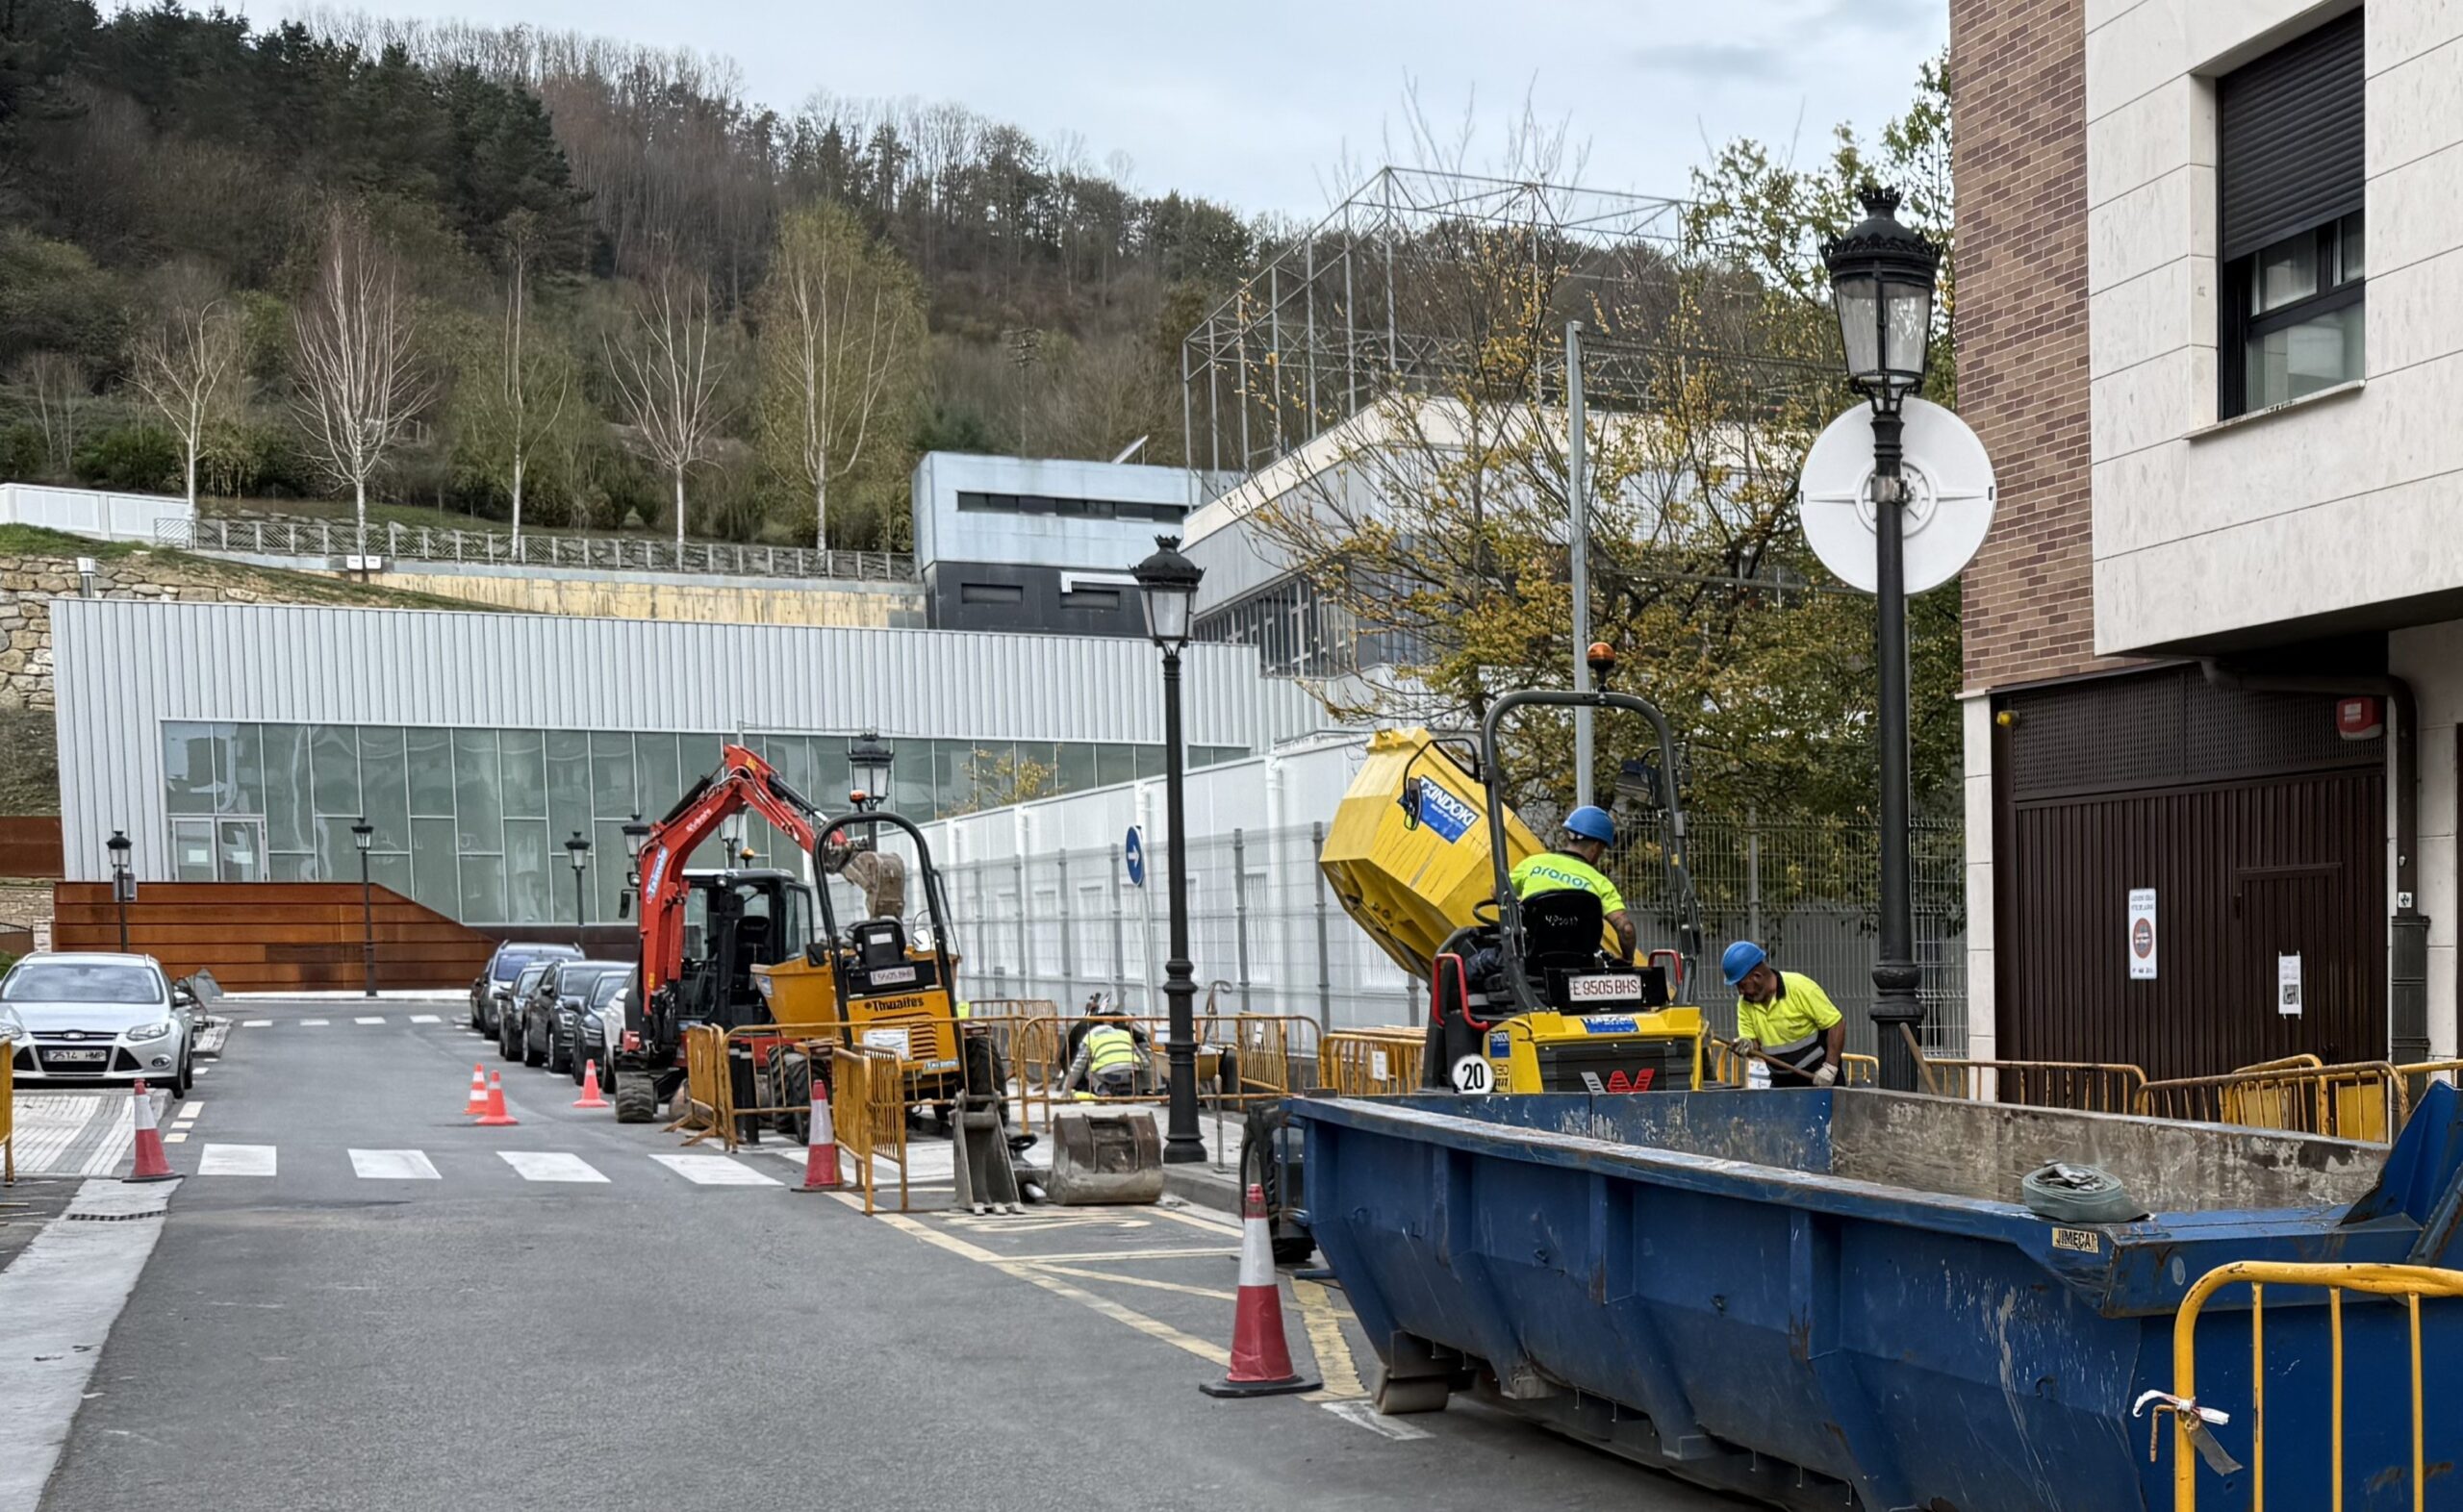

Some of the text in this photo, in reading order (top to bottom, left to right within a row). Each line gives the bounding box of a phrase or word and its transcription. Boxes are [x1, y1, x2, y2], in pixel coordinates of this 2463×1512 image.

[1421, 776, 1479, 826] TXINDOKI
[1583, 980, 1613, 995] 9505
[1615, 979, 1638, 995] BHS
[1462, 1062, 1485, 1091] 20
